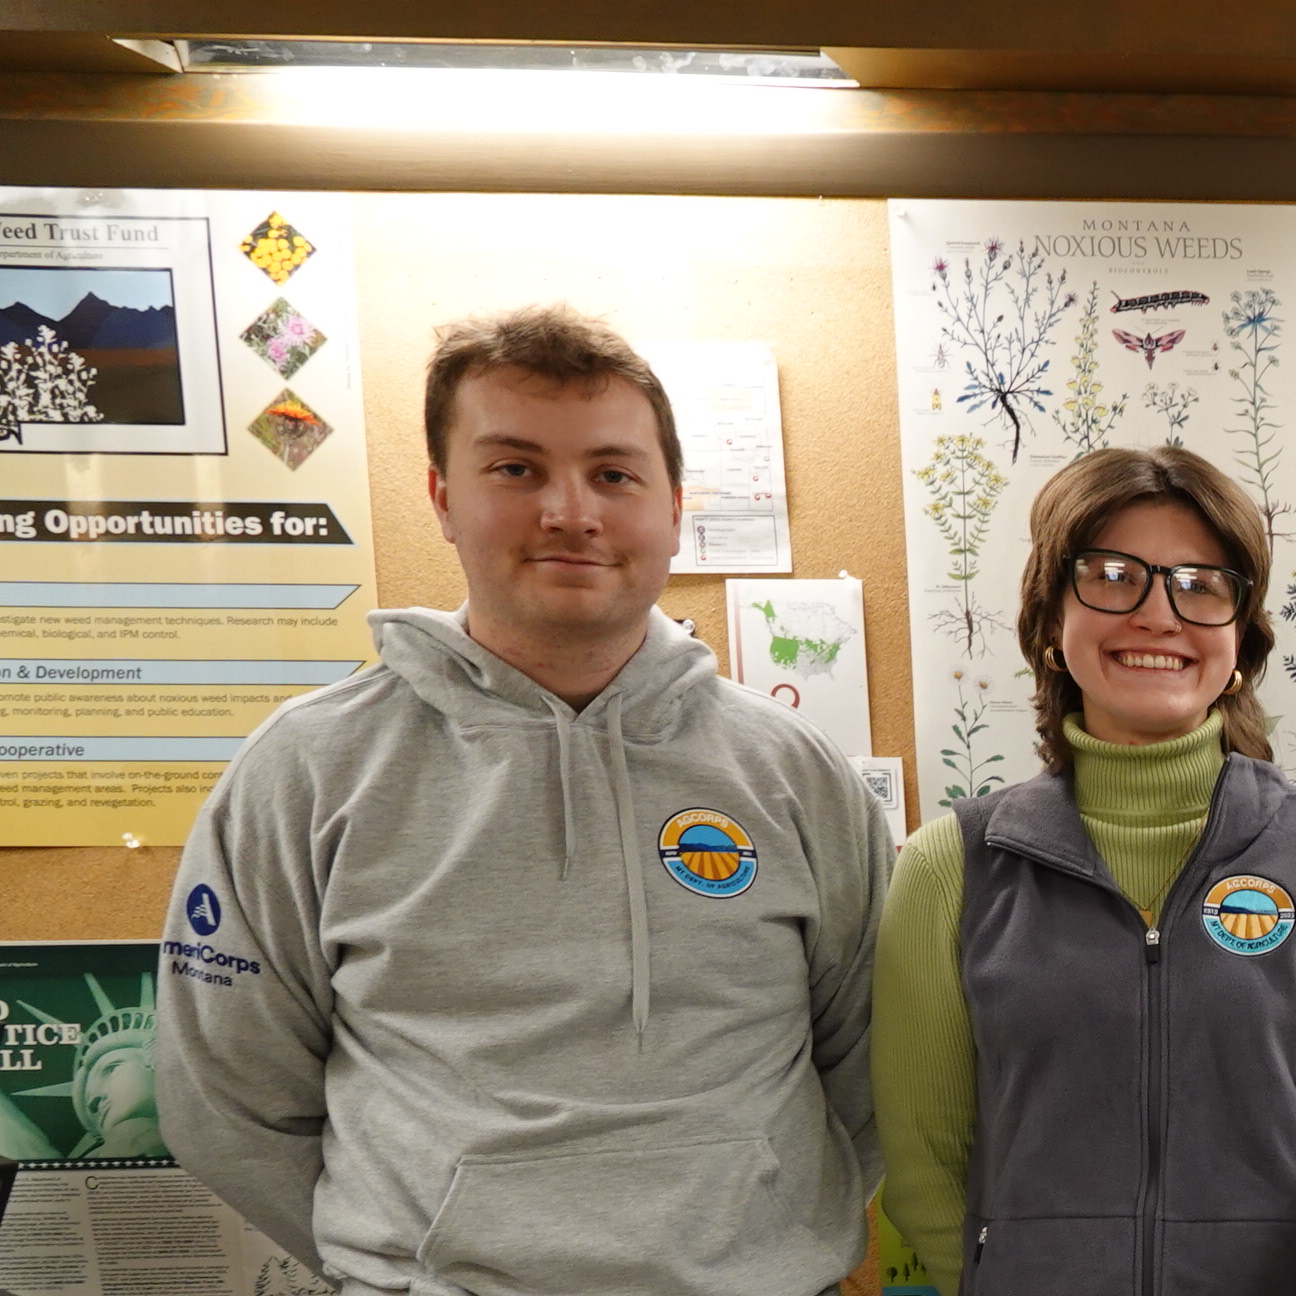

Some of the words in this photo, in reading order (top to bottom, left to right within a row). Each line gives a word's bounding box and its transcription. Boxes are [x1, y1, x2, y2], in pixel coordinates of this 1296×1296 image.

[0, 222, 37, 240] eed
[44, 223, 98, 241] Trust
[107, 224, 159, 241] Fund
[1082, 219, 1190, 232] MONTANA
[1033, 234, 1147, 259] NOXIOUS
[1154, 237, 1243, 260] WEEDS
[1108, 267, 1169, 275] BIOCONTROLS
[44, 509, 263, 539] Opportunities
[270, 510, 328, 536] for:
[39, 616, 60, 625] new
[64, 615, 91, 625] weed
[94, 616, 162, 626] management
[165, 616, 224, 628] techniques.
[227, 616, 274, 626] Research
[277, 617, 298, 628] may
[301, 616, 338, 626] include
[42, 629, 95, 640] biological,
[97, 629, 116, 639] and
[120, 629, 139, 639] IPM
[142, 629, 181, 639] control.
[17, 665, 30, 679] &
[35, 665, 142, 681] Development
[34, 693, 66, 703] public
[68, 694, 124, 702] awareness
[126, 693, 156, 702] about
[159, 694, 198, 703] noxious
[201, 693, 228, 703] weed
[230, 693, 270, 704] impacts
[12, 707, 72, 717] monitoring,
[75, 707, 122, 718] planning,
[125, 707, 144, 716] and
[148, 707, 179, 717] public
[181, 707, 234, 717] education.
[0, 743, 84, 759] ooperative
[22, 770, 64, 780] projects
[67, 770, 88, 780] that
[91, 770, 125, 780] involve
[128, 770, 199, 781] on-the-ground
[22, 785, 92, 795] management
[94, 785, 126, 793] areas.
[132, 784, 173, 795] Projects
[175, 784, 196, 793] also
[23, 798, 63, 808] grazing,
[67, 798, 87, 807] and
[90, 798, 156, 809] revegetation.
[1226, 878, 1276, 894] AGCORPS
[163, 941, 261, 974] meriCorps
[4, 1022, 81, 1046] TICE
